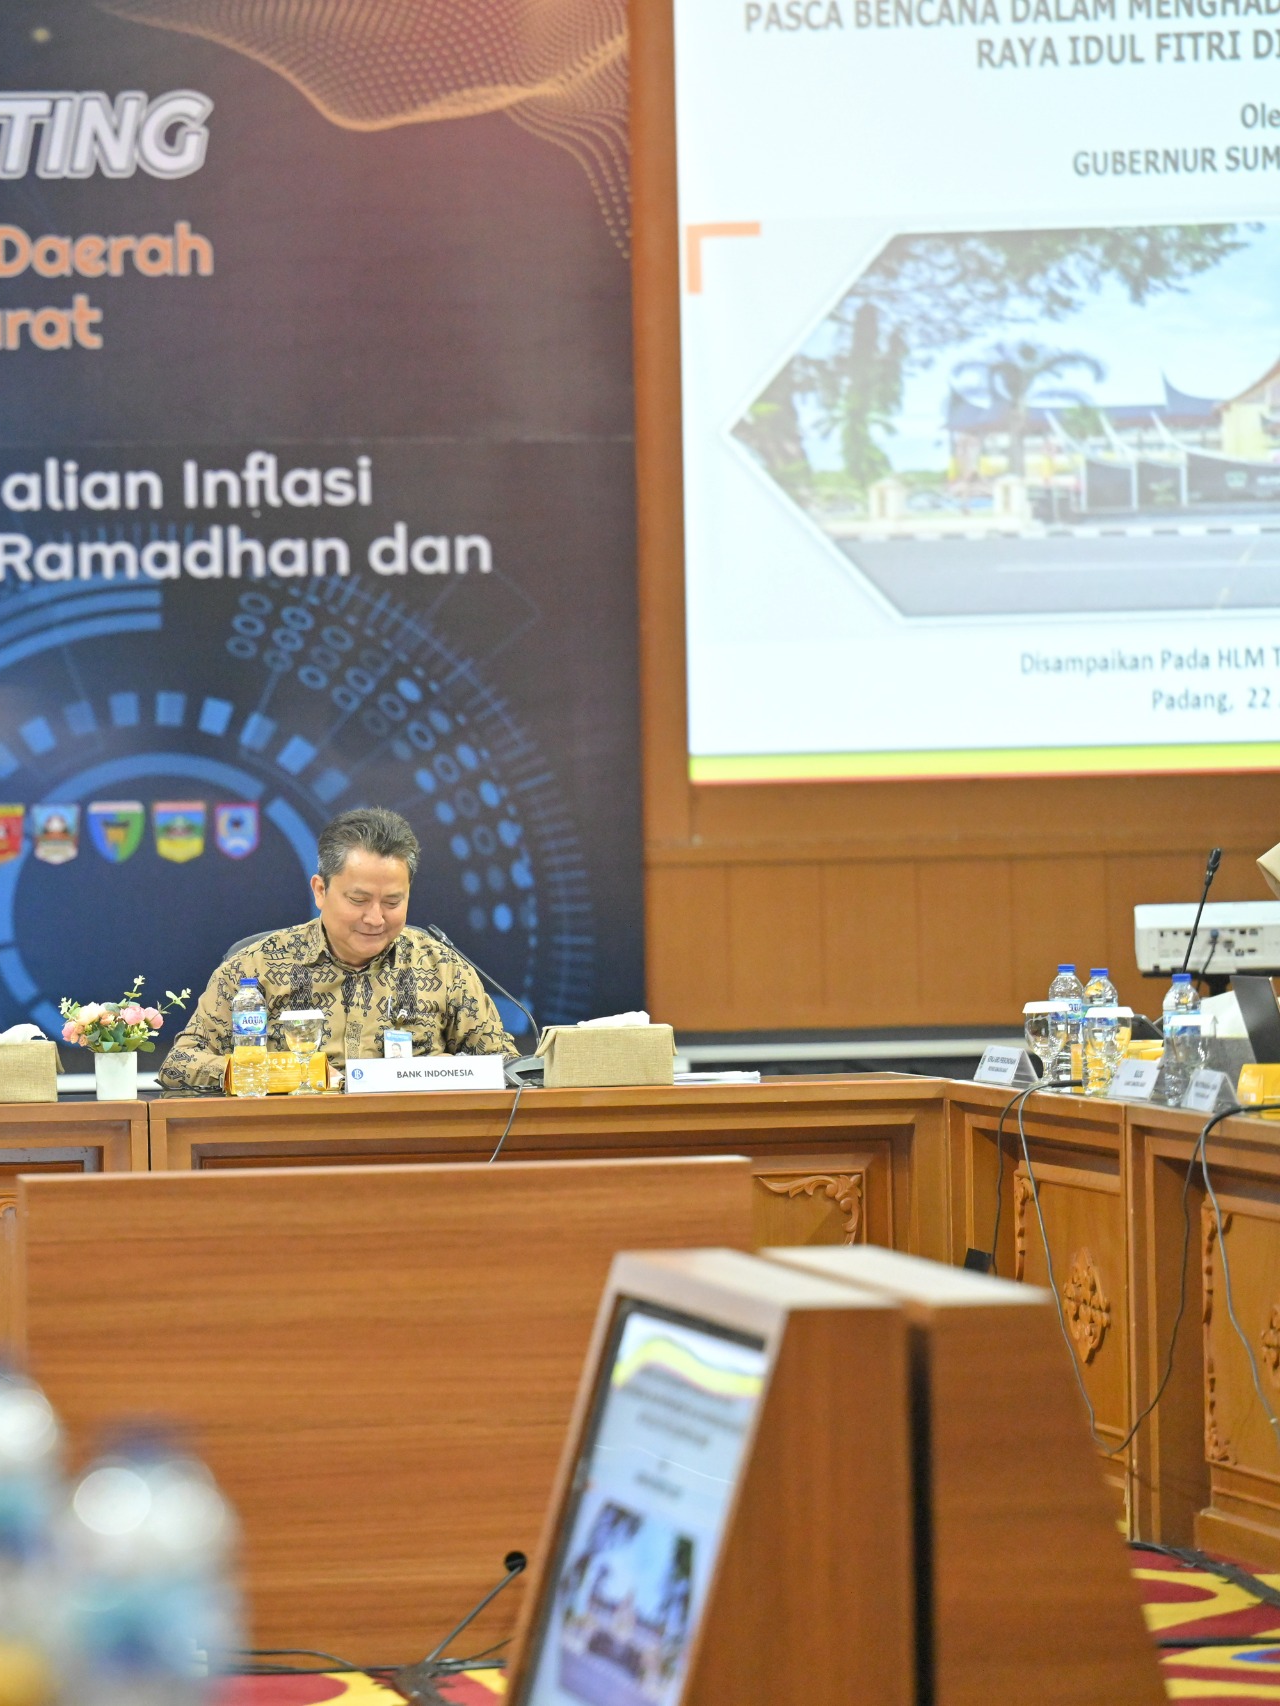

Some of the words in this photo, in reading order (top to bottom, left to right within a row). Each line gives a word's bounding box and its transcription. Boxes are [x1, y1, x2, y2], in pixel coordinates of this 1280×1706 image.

[746, 0, 843, 31] PASCA
[855, 0, 999, 28] BENCANA
[1011, 0, 1115, 23] DALAM
[978, 37, 1058, 68] RAYA
[1069, 34, 1144, 65] IDUL
[1156, 30, 1240, 62] FITRI
[1073, 148, 1217, 176] GUBERNUR
[184, 452, 371, 508] Inflasi
[369, 522, 491, 575] dan
[1020, 650, 1154, 677] Disampaikan
[1161, 649, 1209, 669] Pada
[1219, 648, 1263, 668] HLM
[1152, 689, 1233, 714] Padang,
[1248, 688, 1270, 708] 22
[242, 1016, 264, 1026] AQUA
[396, 1070, 422, 1079] BANK
[424, 1069, 474, 1078] INDONESIA
